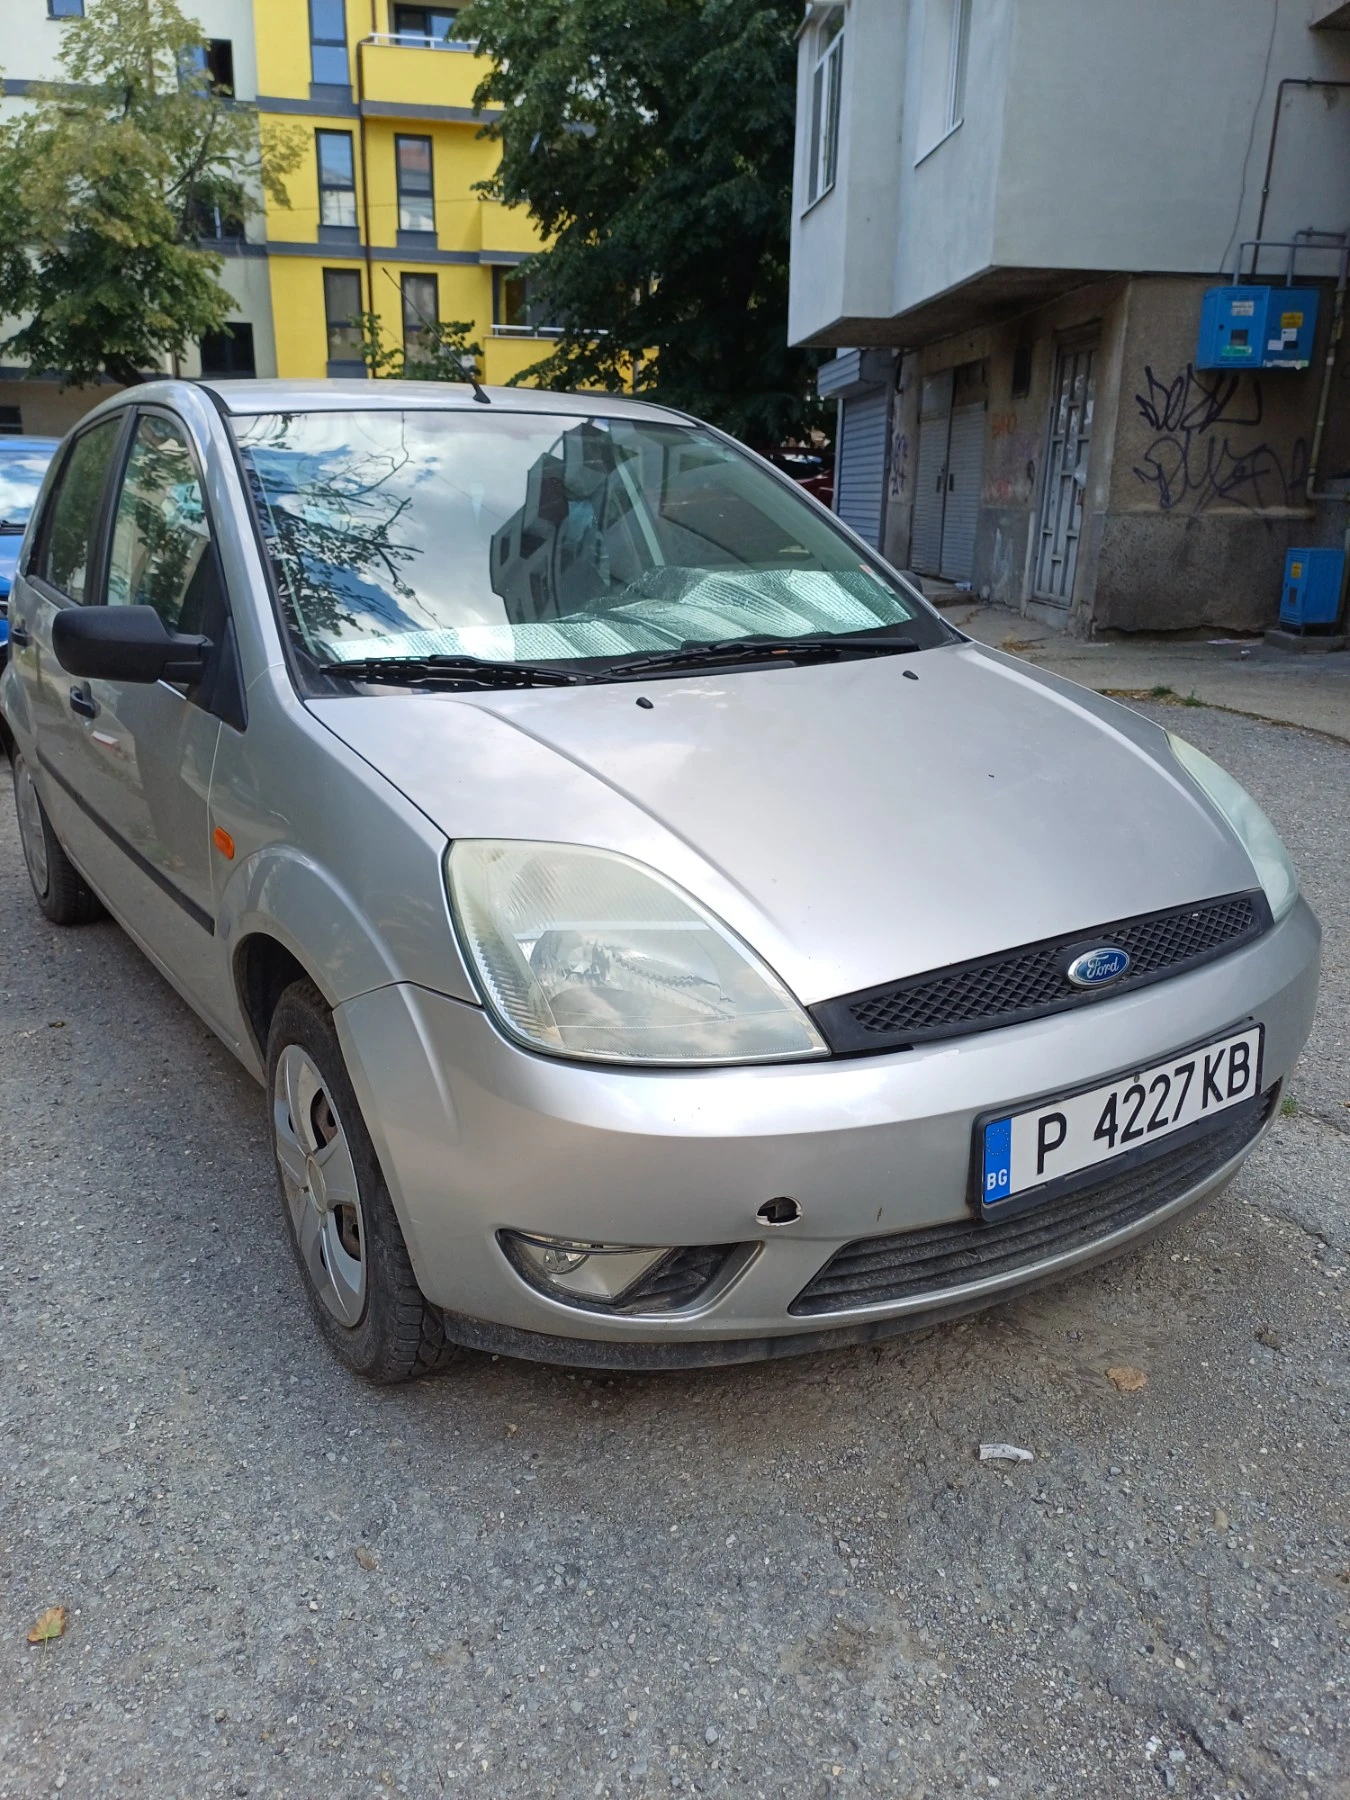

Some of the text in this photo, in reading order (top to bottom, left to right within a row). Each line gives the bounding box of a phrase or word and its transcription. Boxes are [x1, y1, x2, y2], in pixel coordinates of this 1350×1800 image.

[1086, 954, 1120, 979] Ford
[1036, 1041, 1251, 1175] P 4227 KB
[986, 1168, 1008, 1191] BG
